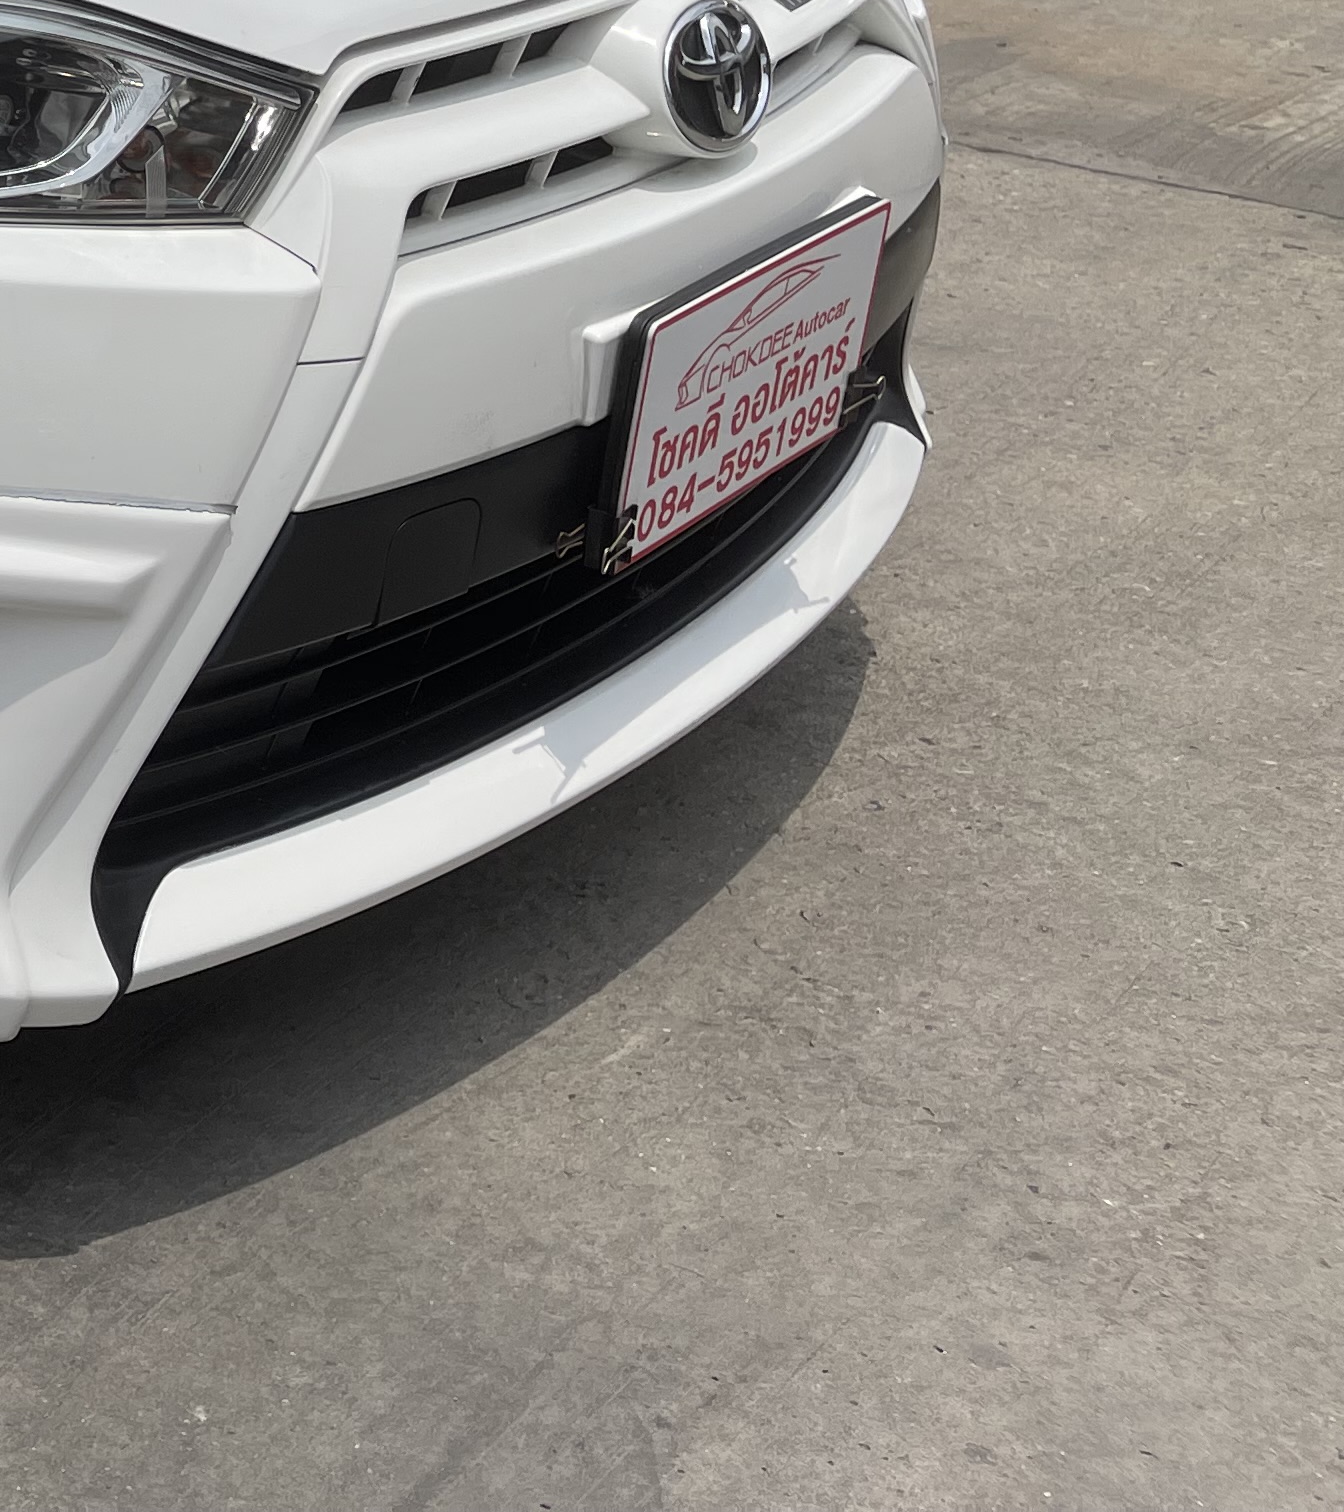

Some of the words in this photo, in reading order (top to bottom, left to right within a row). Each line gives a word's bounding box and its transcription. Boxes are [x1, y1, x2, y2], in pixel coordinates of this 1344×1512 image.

[647, 392, 726, 488] โชคดี
[730, 317, 856, 436] ออโต้คาร์
[706, 322, 795, 394] CHOKDEE
[793, 297, 852, 345] Autocar
[636, 385, 841, 543] 084-5951999
